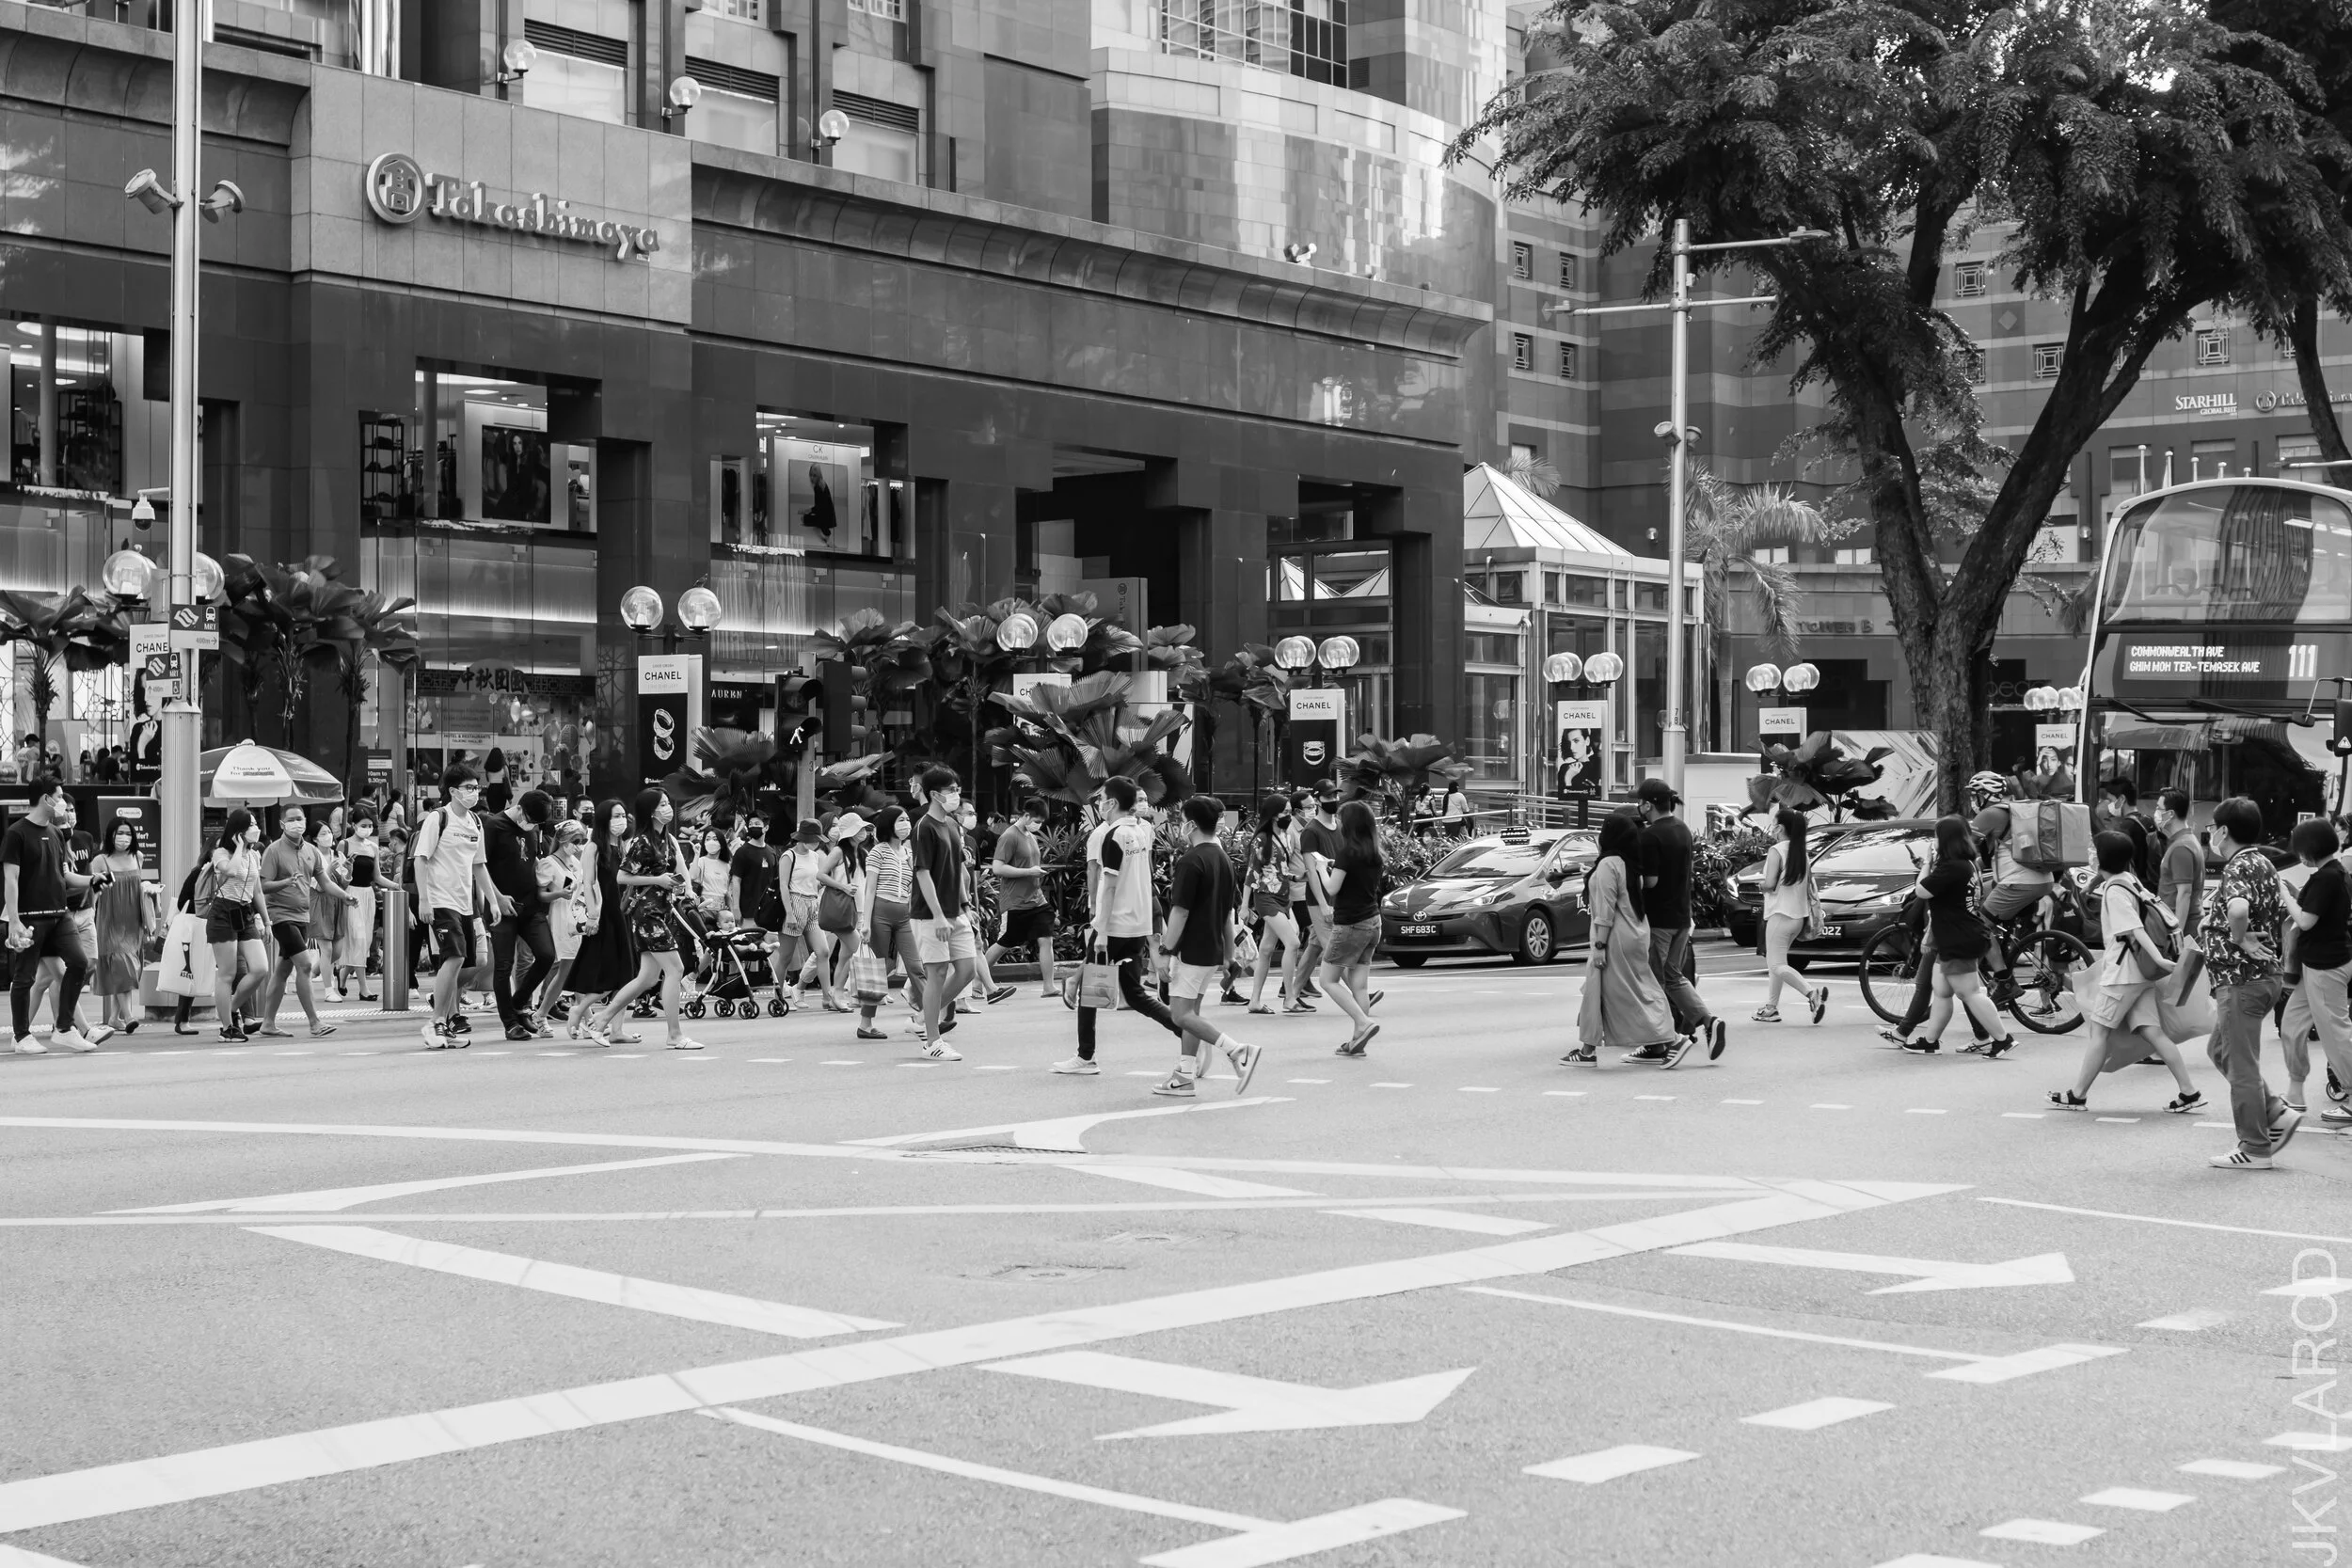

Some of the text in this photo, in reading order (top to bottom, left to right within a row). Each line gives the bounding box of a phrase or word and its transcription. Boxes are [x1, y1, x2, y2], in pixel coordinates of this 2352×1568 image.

[424, 172, 660, 260] Takashimaya
[2175, 393, 2237, 410] STARHILL
[2200, 406, 2224, 415] GLOBAL
[1798, 619, 1873, 633] TOWER B
[135, 642, 168, 653] CHANE
[2131, 646, 2225, 657] COMMONWEALTH AVE
[2288, 644, 2316, 677] 111
[2129, 661, 2261, 673] GHIM MOH TER-TEMASEK AVE
[644, 671, 682, 681] CHANEL
[711, 689, 742, 699] AUREN
[1296, 702, 1331, 710] CHANEL
